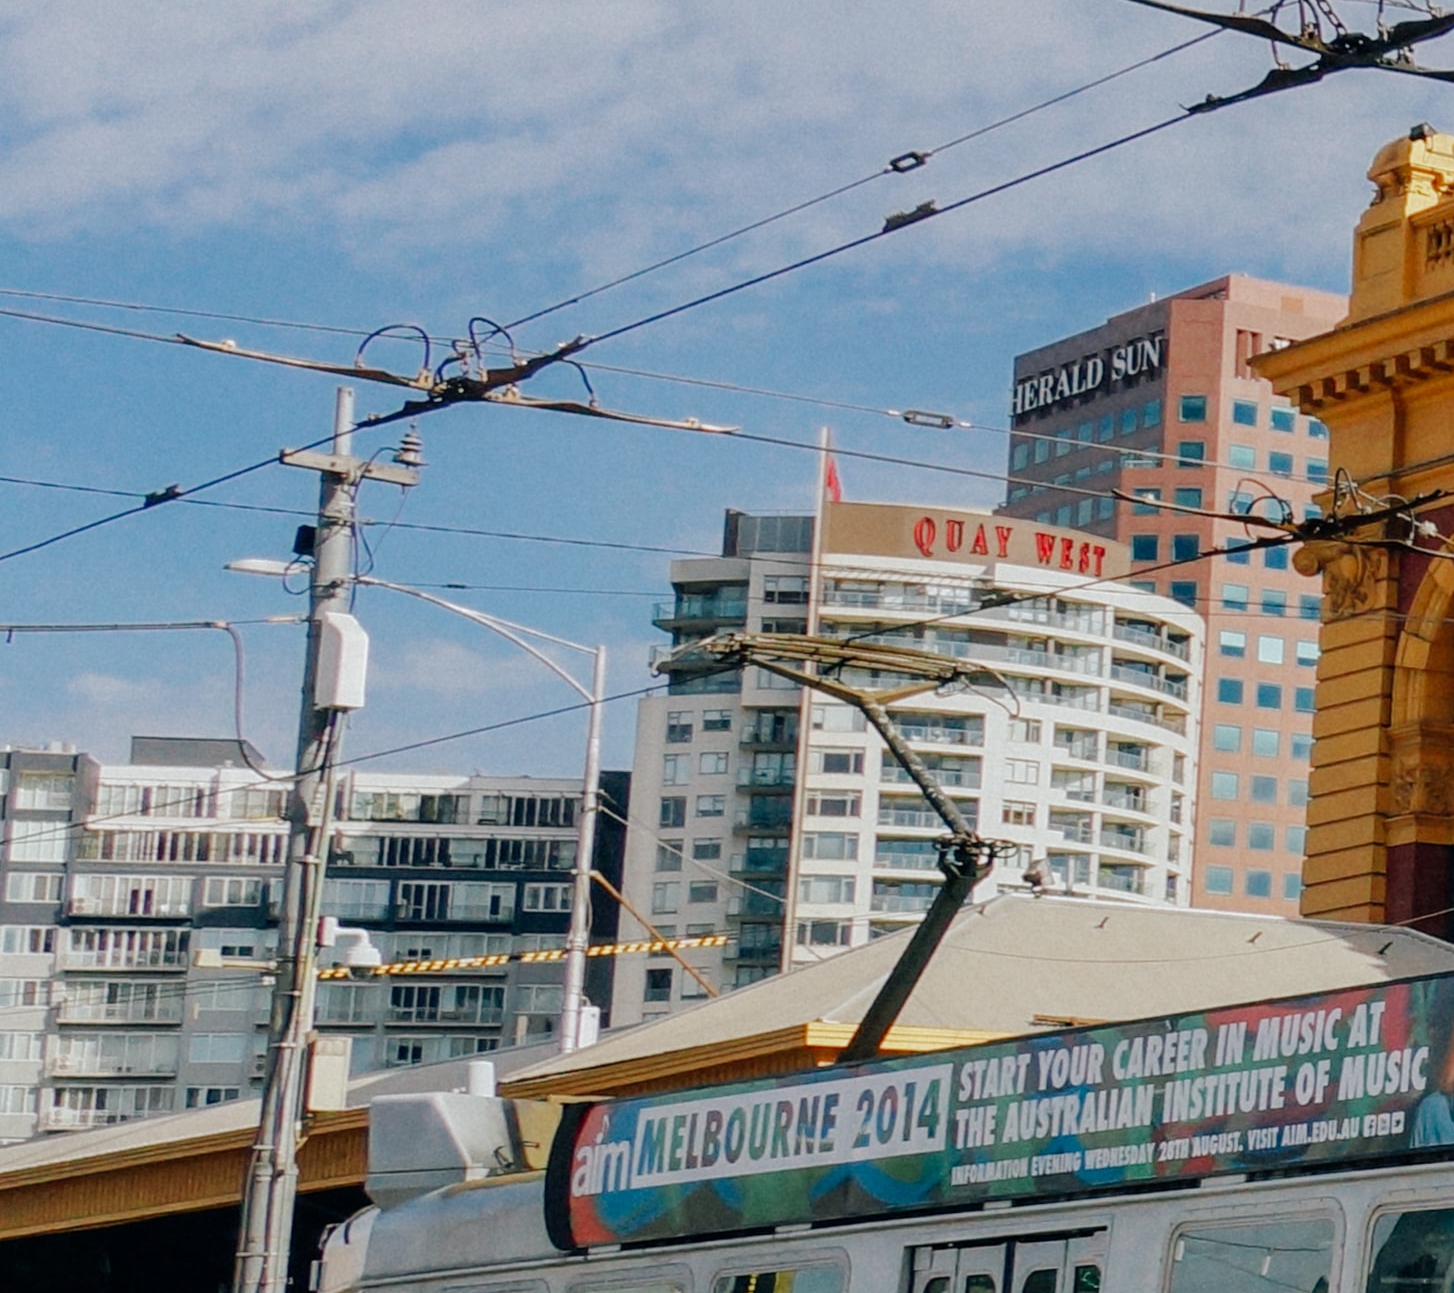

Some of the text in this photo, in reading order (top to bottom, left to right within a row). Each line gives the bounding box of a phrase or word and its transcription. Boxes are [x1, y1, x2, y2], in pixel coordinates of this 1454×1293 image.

[1010, 336, 1168, 415] HERALD SUN
[914, 517, 1106, 577] QUAY WEST
[958, 1001, 1385, 1102] START YOUR CAREER IN MUSIC AT
[637, 1078, 940, 1178] MELBOURNE 2014
[954, 1047, 1429, 1149] THE AUSTRALIAN INSTITUTE OF MUSIC
[572, 1124, 632, 1197] aim
[951, 1117, 1360, 1186] INFORMATION EVENING WEDNESDAY 28TH AUGUST. VISIT AIM.EDU.AU
